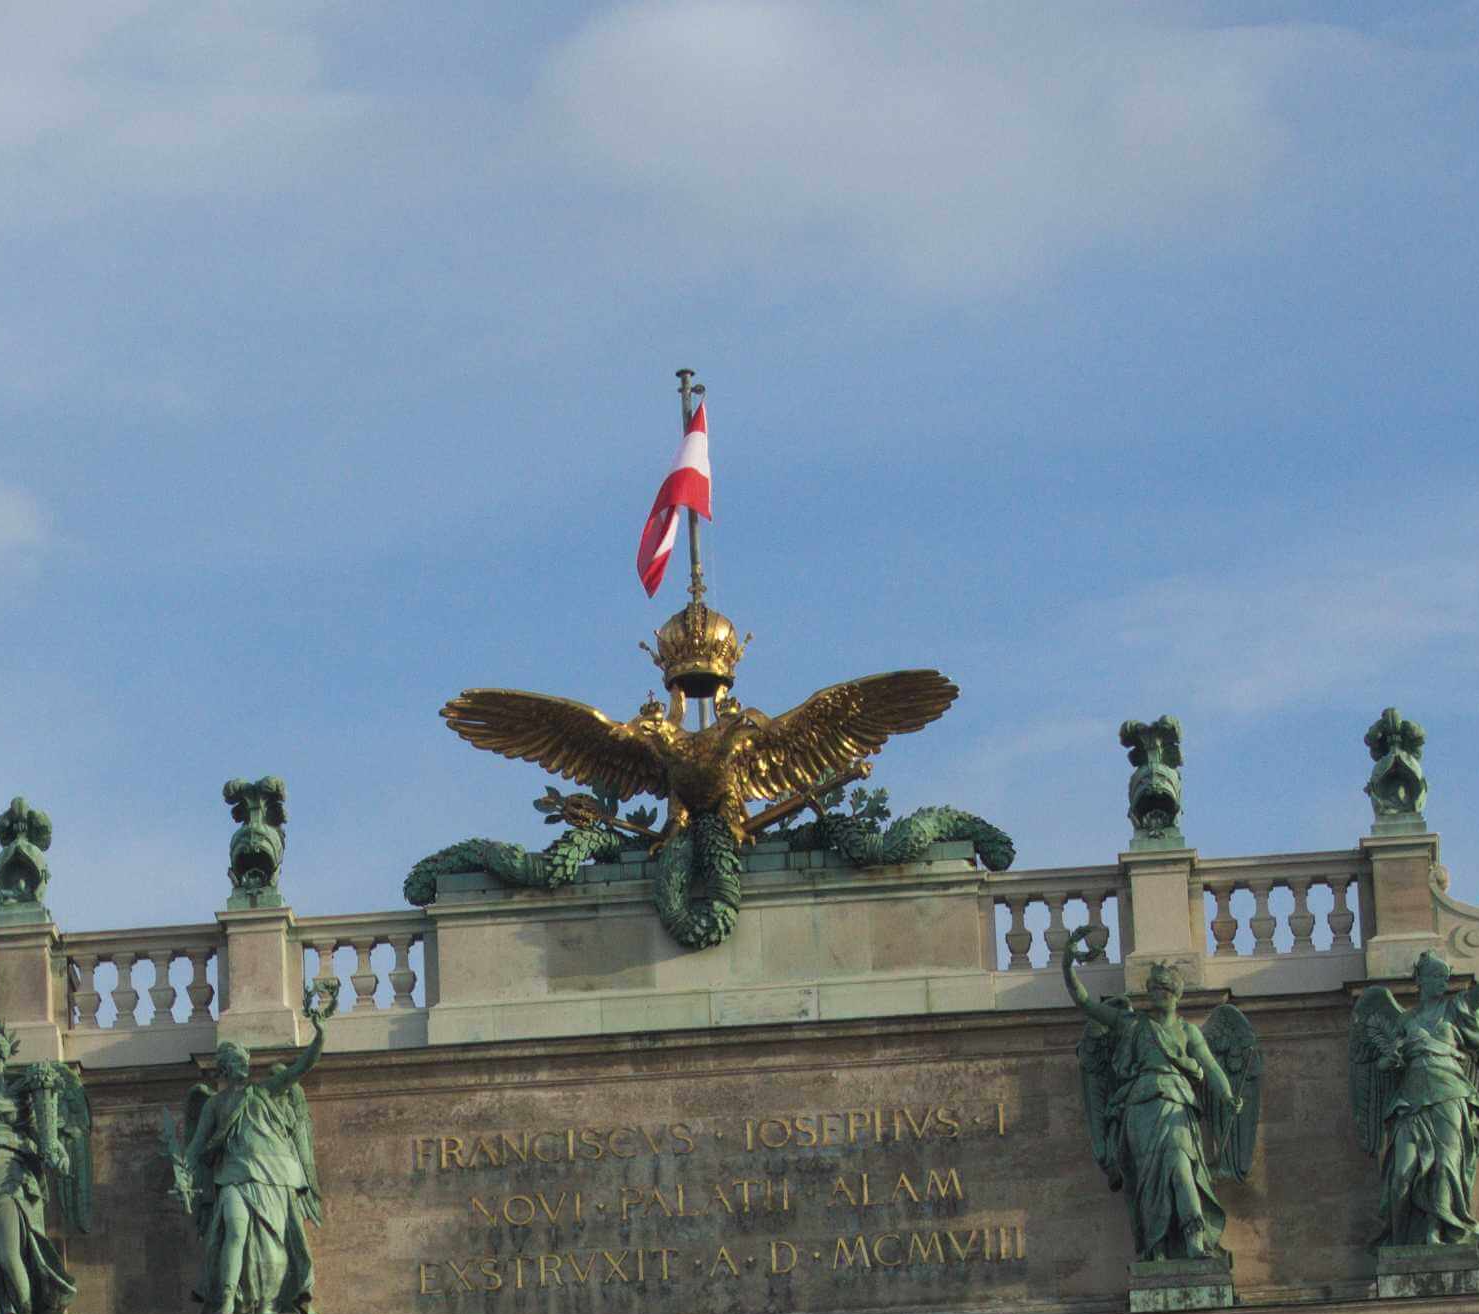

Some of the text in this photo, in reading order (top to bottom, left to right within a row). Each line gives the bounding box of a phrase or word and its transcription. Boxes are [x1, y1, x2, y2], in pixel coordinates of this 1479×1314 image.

[412, 1103, 1006, 1169] FRANCISCVS IOSEPHVS I
[470, 1167, 964, 1227] NOVI PALATII ALAM
[419, 1248, 678, 1294] EXSTRVXIT
[832, 1224, 1026, 1271] MCMVIII
